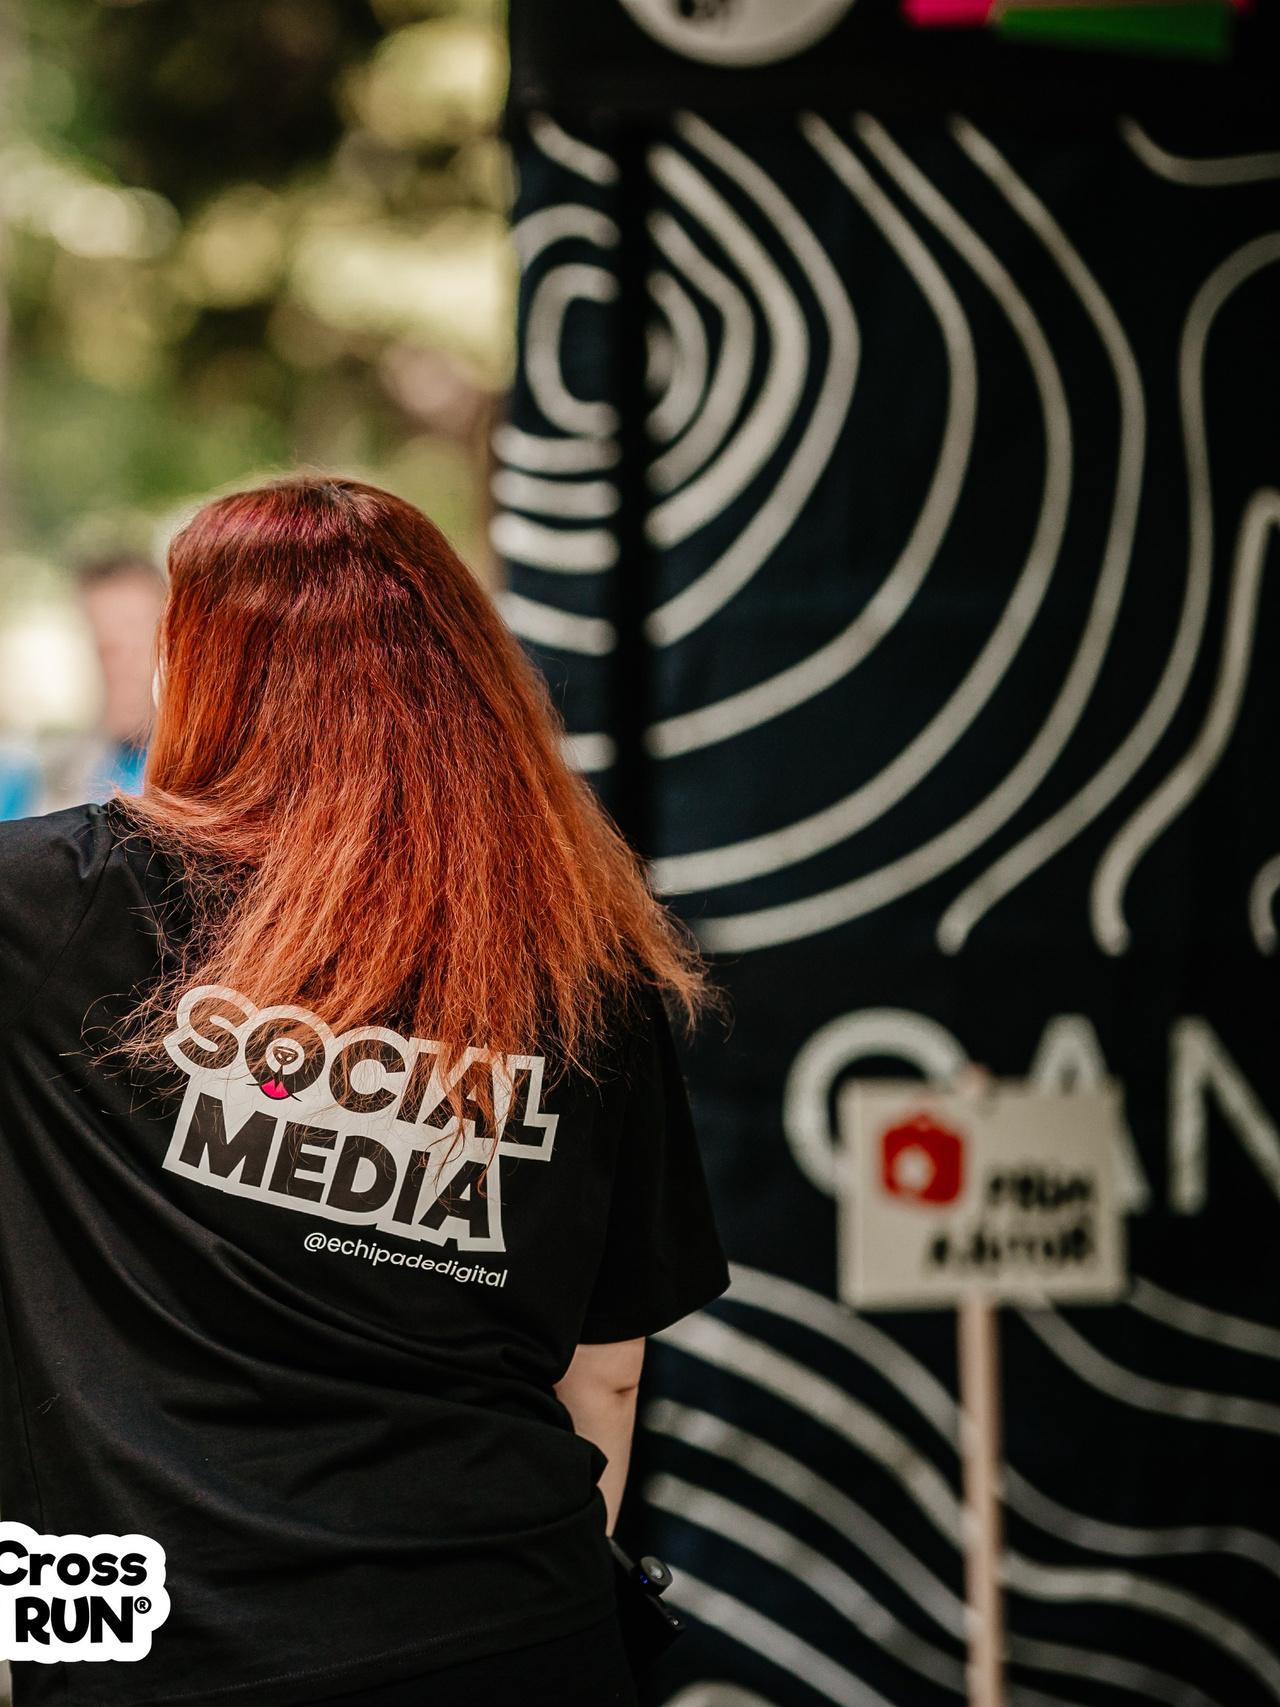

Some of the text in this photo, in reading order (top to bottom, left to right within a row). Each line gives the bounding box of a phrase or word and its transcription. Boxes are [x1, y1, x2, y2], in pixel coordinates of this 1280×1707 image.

[177, 996, 548, 1147] SOCIAL
[178, 1092, 491, 1239] MEDIA
[303, 1232, 509, 1289] @echipadedigital
